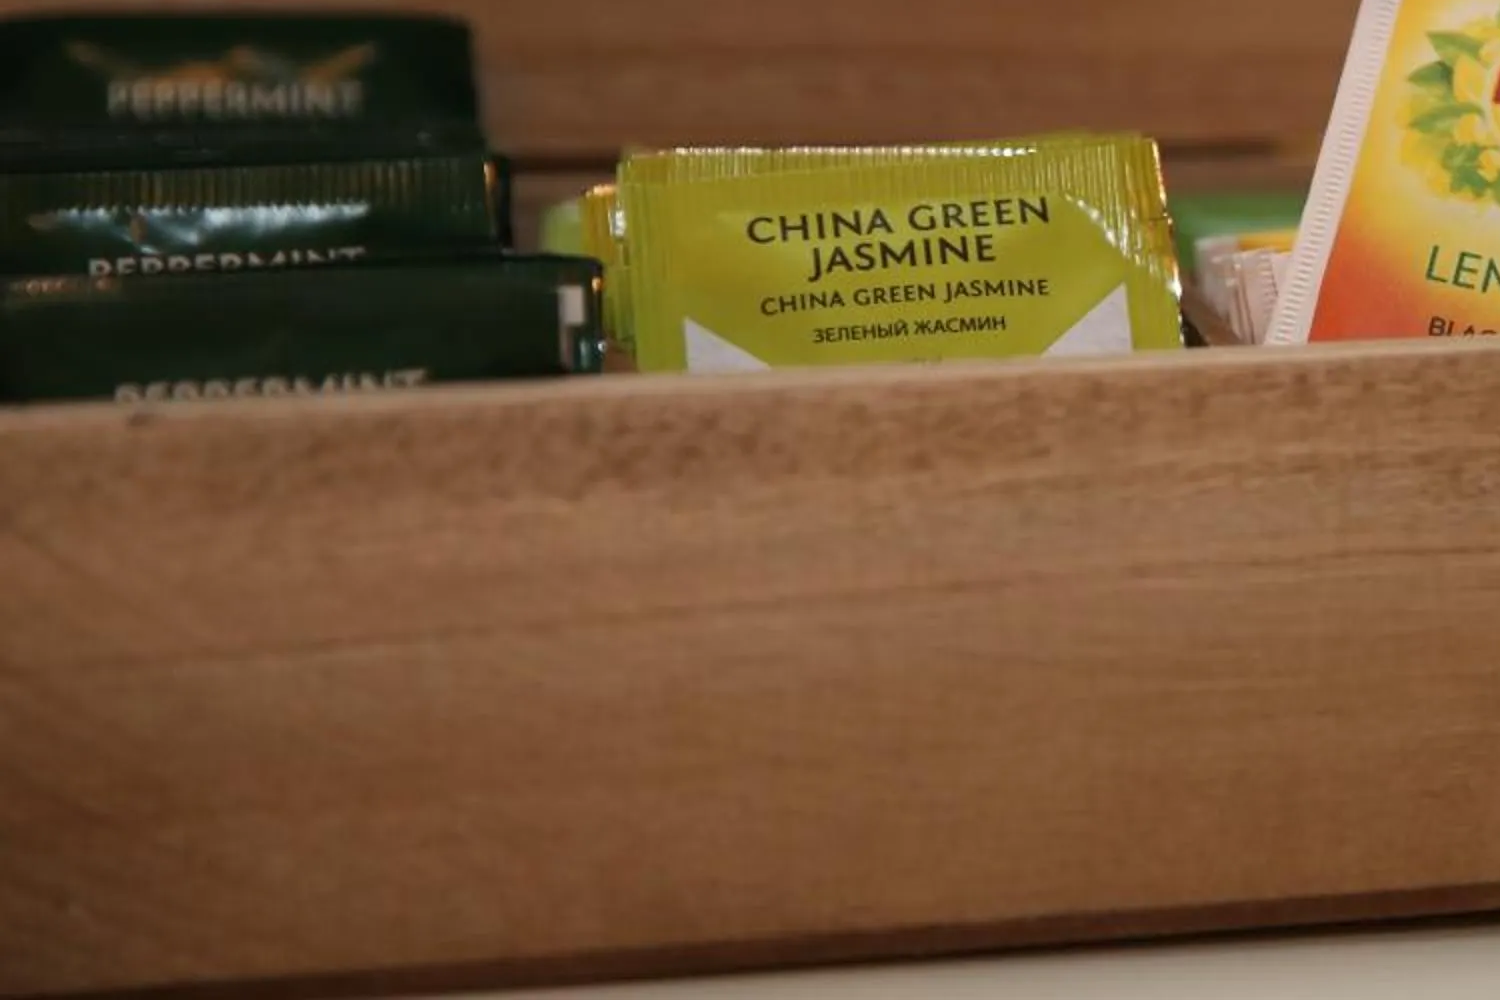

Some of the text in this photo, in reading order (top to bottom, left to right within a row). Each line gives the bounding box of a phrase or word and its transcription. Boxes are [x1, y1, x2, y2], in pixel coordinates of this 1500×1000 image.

[106, 80, 363, 116] PEPPERMINT
[746, 196, 1050, 244] CHINA GREEN
[808, 234, 997, 283] JASMINE
[760, 279, 1049, 316] CHINA GREEN JASMINE
[812, 315, 1007, 344] ЗЕЛЕНЫЙ ЖАСМИН
